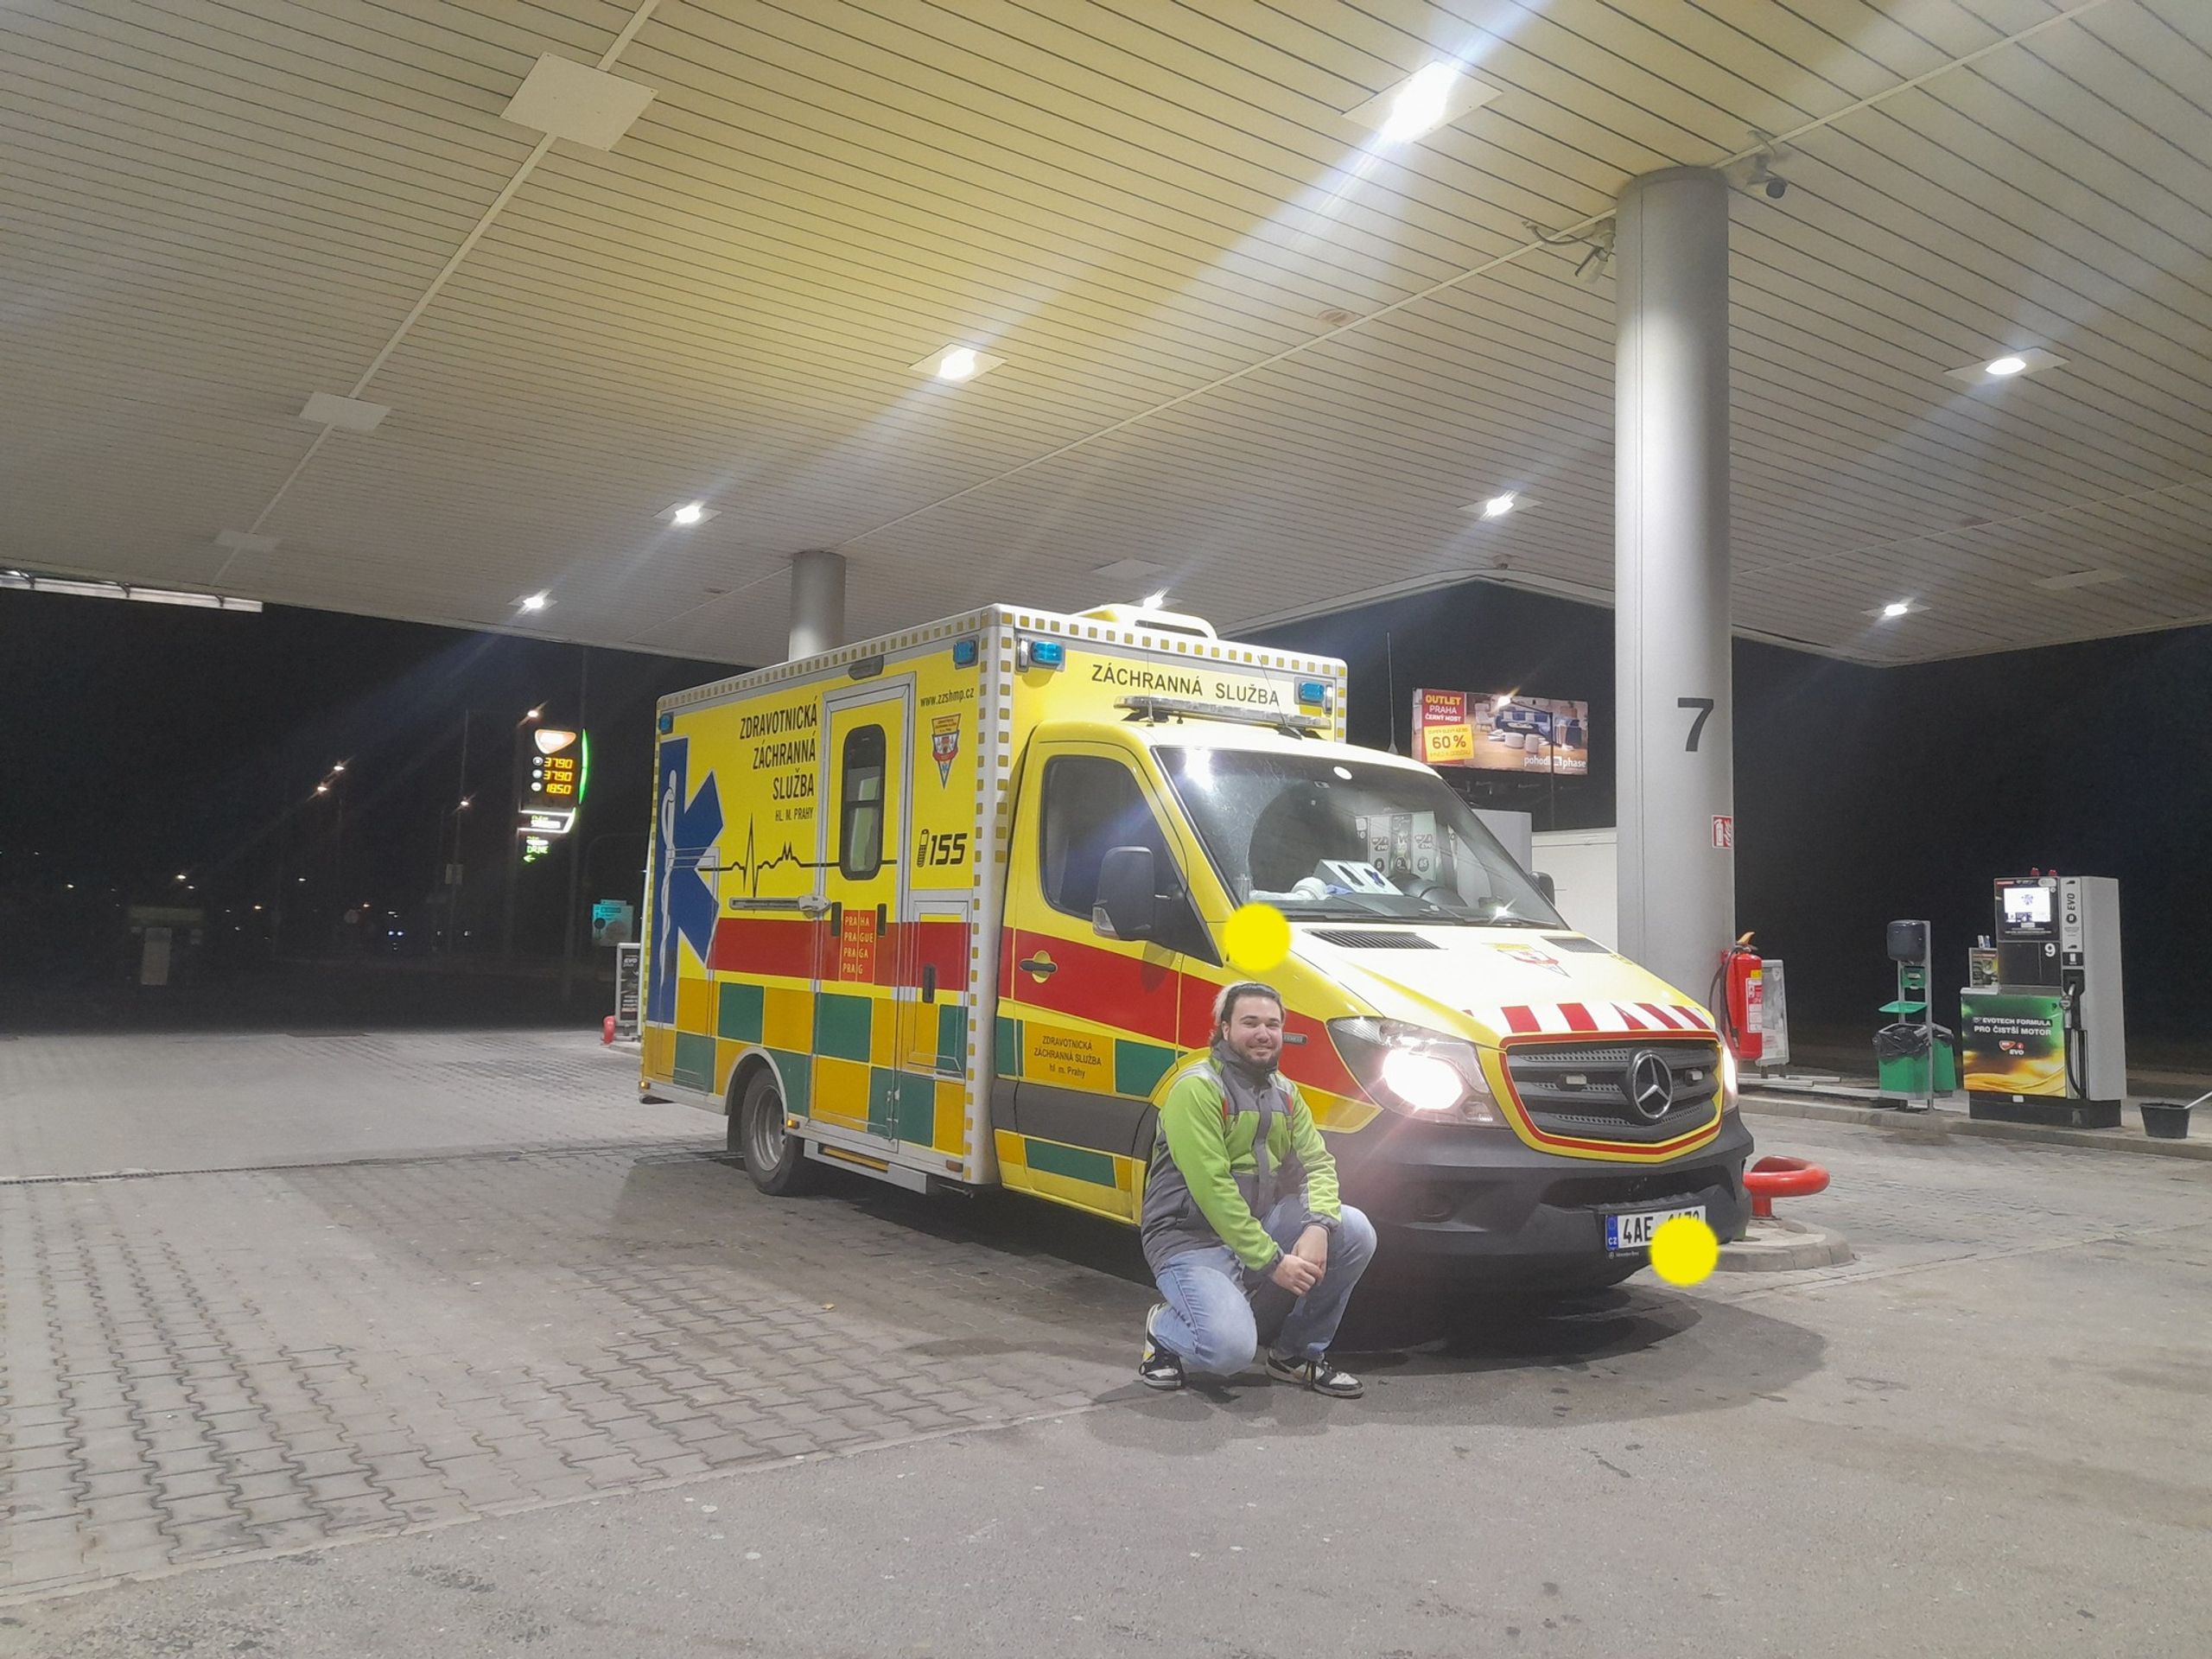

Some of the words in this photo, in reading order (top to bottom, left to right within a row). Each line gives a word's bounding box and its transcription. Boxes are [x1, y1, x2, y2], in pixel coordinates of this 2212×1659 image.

[1091, 663, 1203, 696] ZÁCHRANNÁ
[1215, 683, 1281, 707] SLUŽBA
[920, 688, 975, 707] www.zzshmp.cz
[1426, 695, 1462, 705] OUTLET
[740, 695, 818, 740] ZDRAVOTNICKÁ
[1429, 705, 1458, 715] PRAHA
[1677, 697, 1714, 752] 7
[753, 730, 816, 770] ZÁCHRANNÁ
[1562, 757, 1586, 770] phase
[772, 766, 815, 800] SLUŽBA
[793, 806, 814, 820] PRAHY
[929, 832, 968, 866] 155
[2066, 893, 2075, 911] EVO
[844, 916, 870, 927] PRAHA
[843, 931, 874, 943] PRAGUE
[842, 947, 868, 959] PRAGA
[2044, 943, 2056, 957] 9
[842, 963, 863, 975] PRAG
[2020, 1027, 2051, 1036] MOTOR
[1042, 1035, 1093, 1052] ZDRAVOTNICKÁ
[1034, 1046, 1074, 1063] ZÁCHRANNÁ
[1075, 1052, 1103, 1066] SLUŽBA
[1623, 1216, 1654, 1244] 4AE
[1608, 1236, 1618, 1245] CZ
